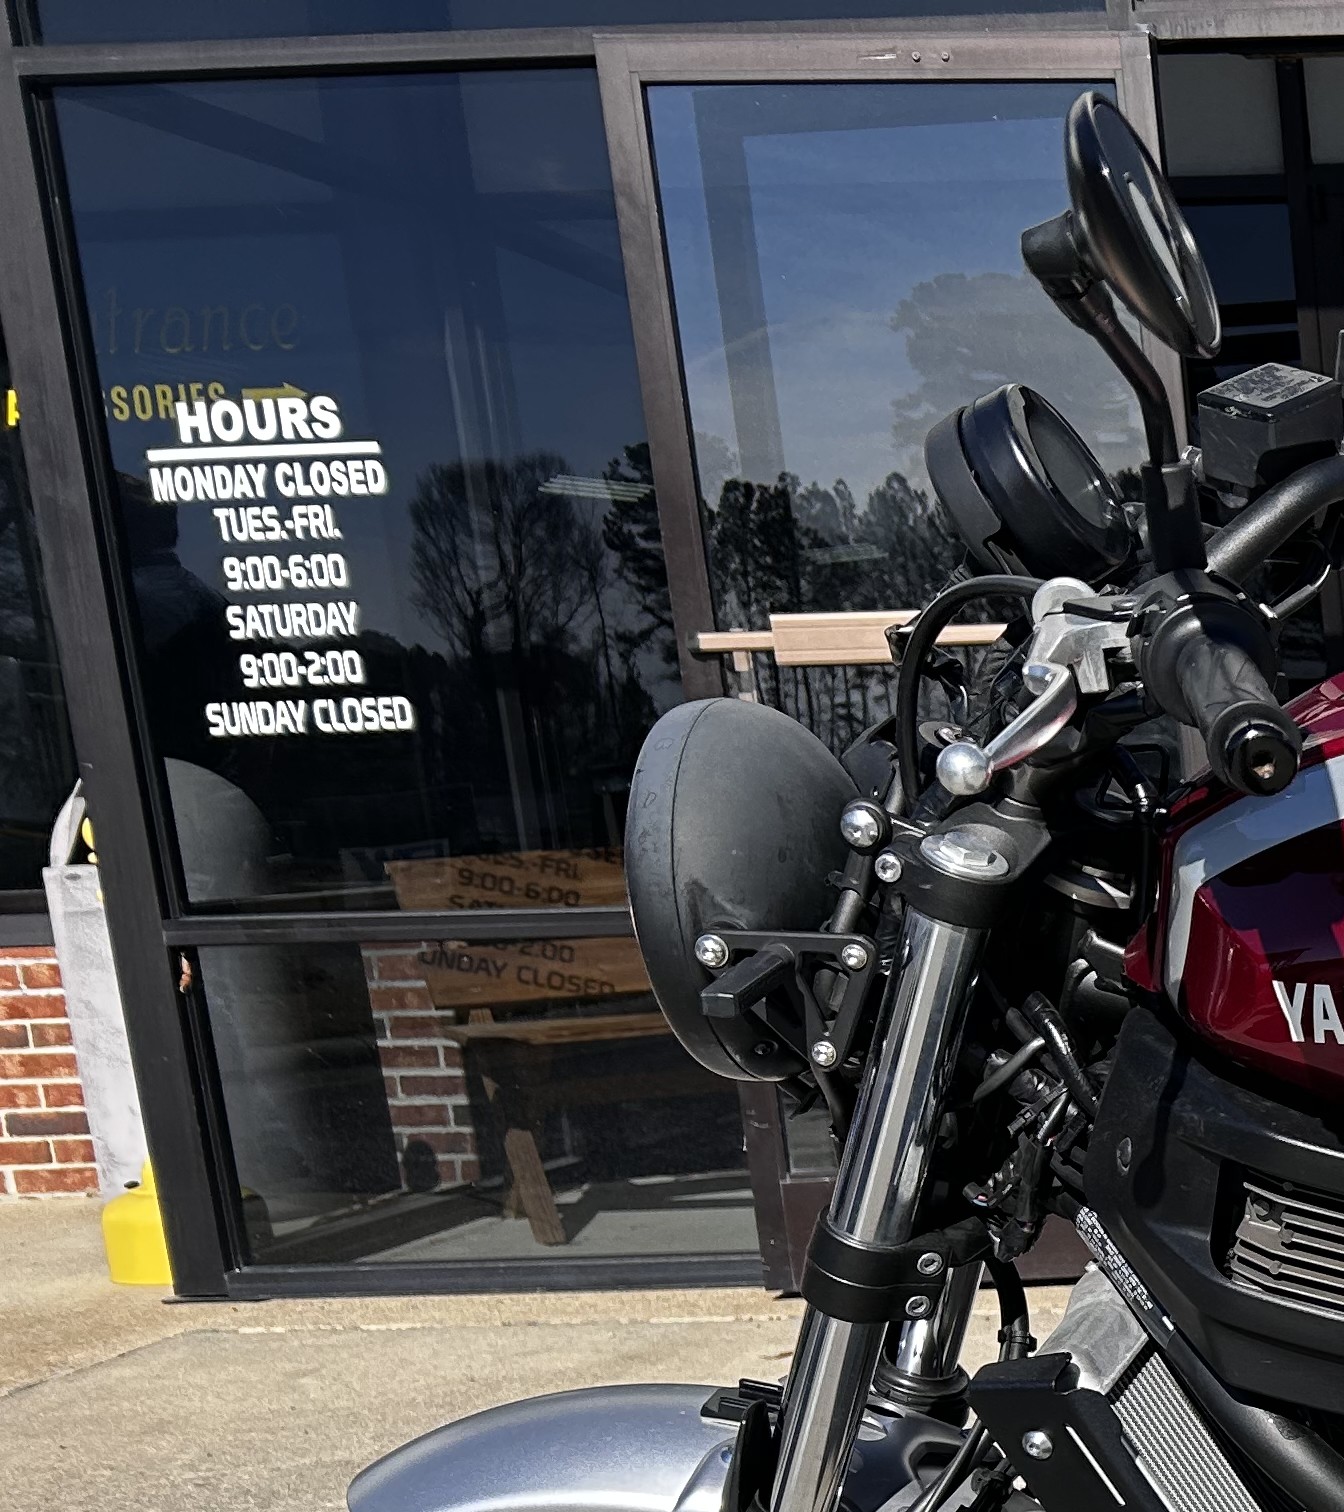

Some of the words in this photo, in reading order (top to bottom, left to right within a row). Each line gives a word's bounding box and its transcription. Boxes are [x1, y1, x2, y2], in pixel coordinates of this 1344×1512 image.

[174, 395, 343, 444] HOURS
[149, 464, 267, 503] MONDAY
[274, 460, 387, 497] CLOSED
[213, 505, 343, 543] TUES.-FRI.
[223, 553, 350, 590] 9:00-6:00
[226, 602, 359, 640] SATURDAY
[239, 650, 365, 688] 9:00-2:00
[205, 701, 306, 737] SUNDAY
[313, 697, 416, 732] CLOSED
